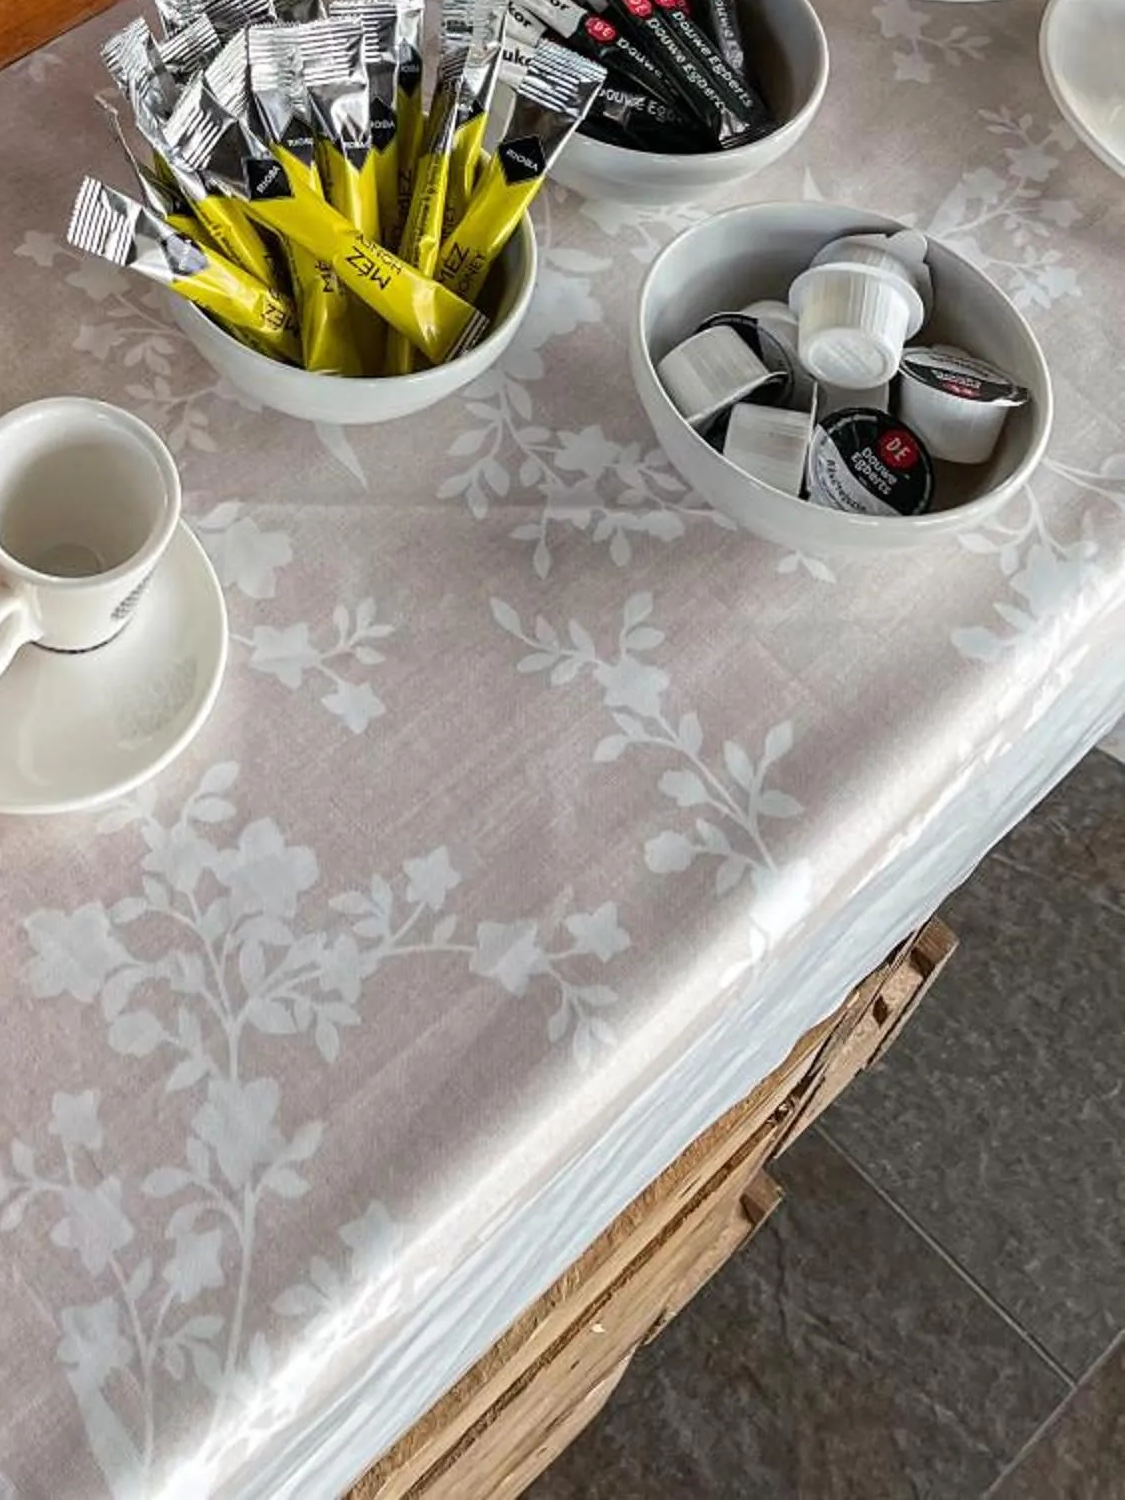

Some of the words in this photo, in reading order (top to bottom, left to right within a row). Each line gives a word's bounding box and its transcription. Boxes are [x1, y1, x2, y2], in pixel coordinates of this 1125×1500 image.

[646, 17, 687, 64] Douwe
[851, 451, 892, 495] Egberts
[861, 446, 898, 485] Douwe
